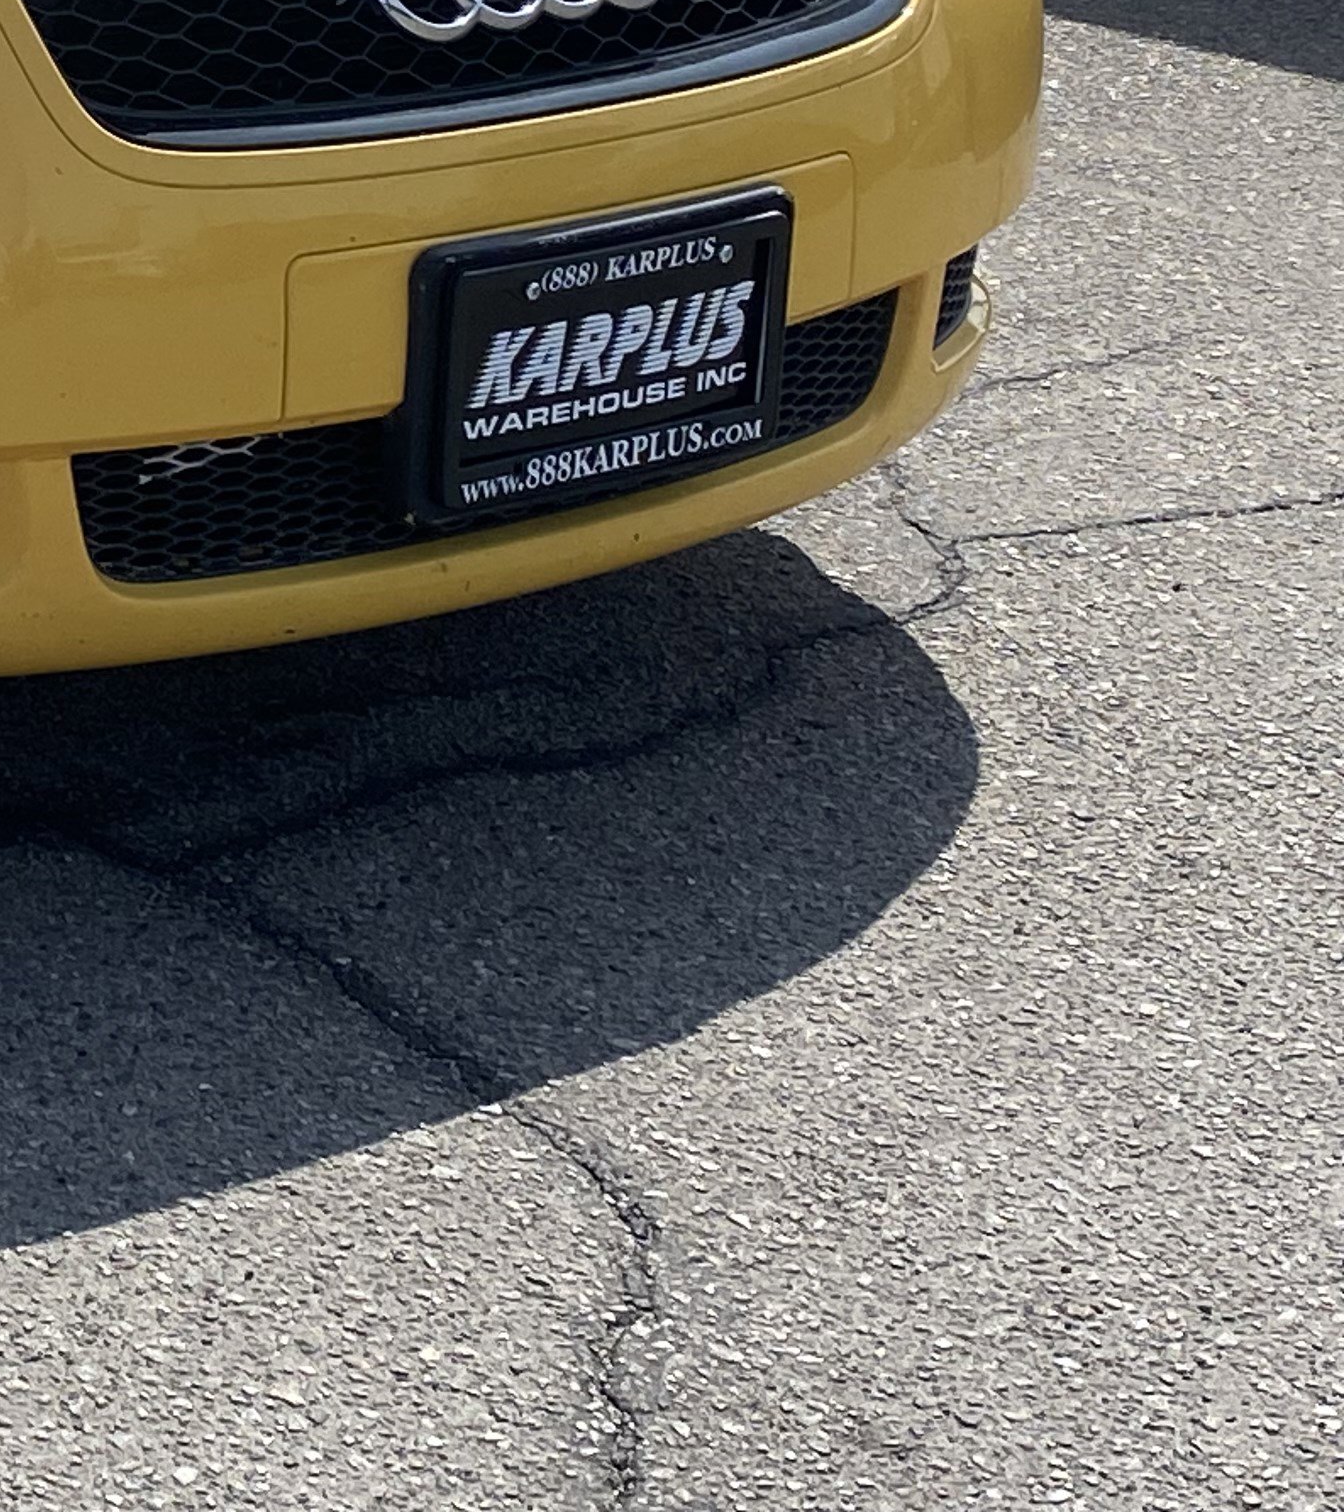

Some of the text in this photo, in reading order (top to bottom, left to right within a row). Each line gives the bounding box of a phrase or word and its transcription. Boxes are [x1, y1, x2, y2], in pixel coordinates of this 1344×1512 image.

[541, 236, 717, 293] (888) KARPLUS
[464, 280, 756, 409] KARPLUS
[463, 361, 748, 440] WAREHOUSE INC
